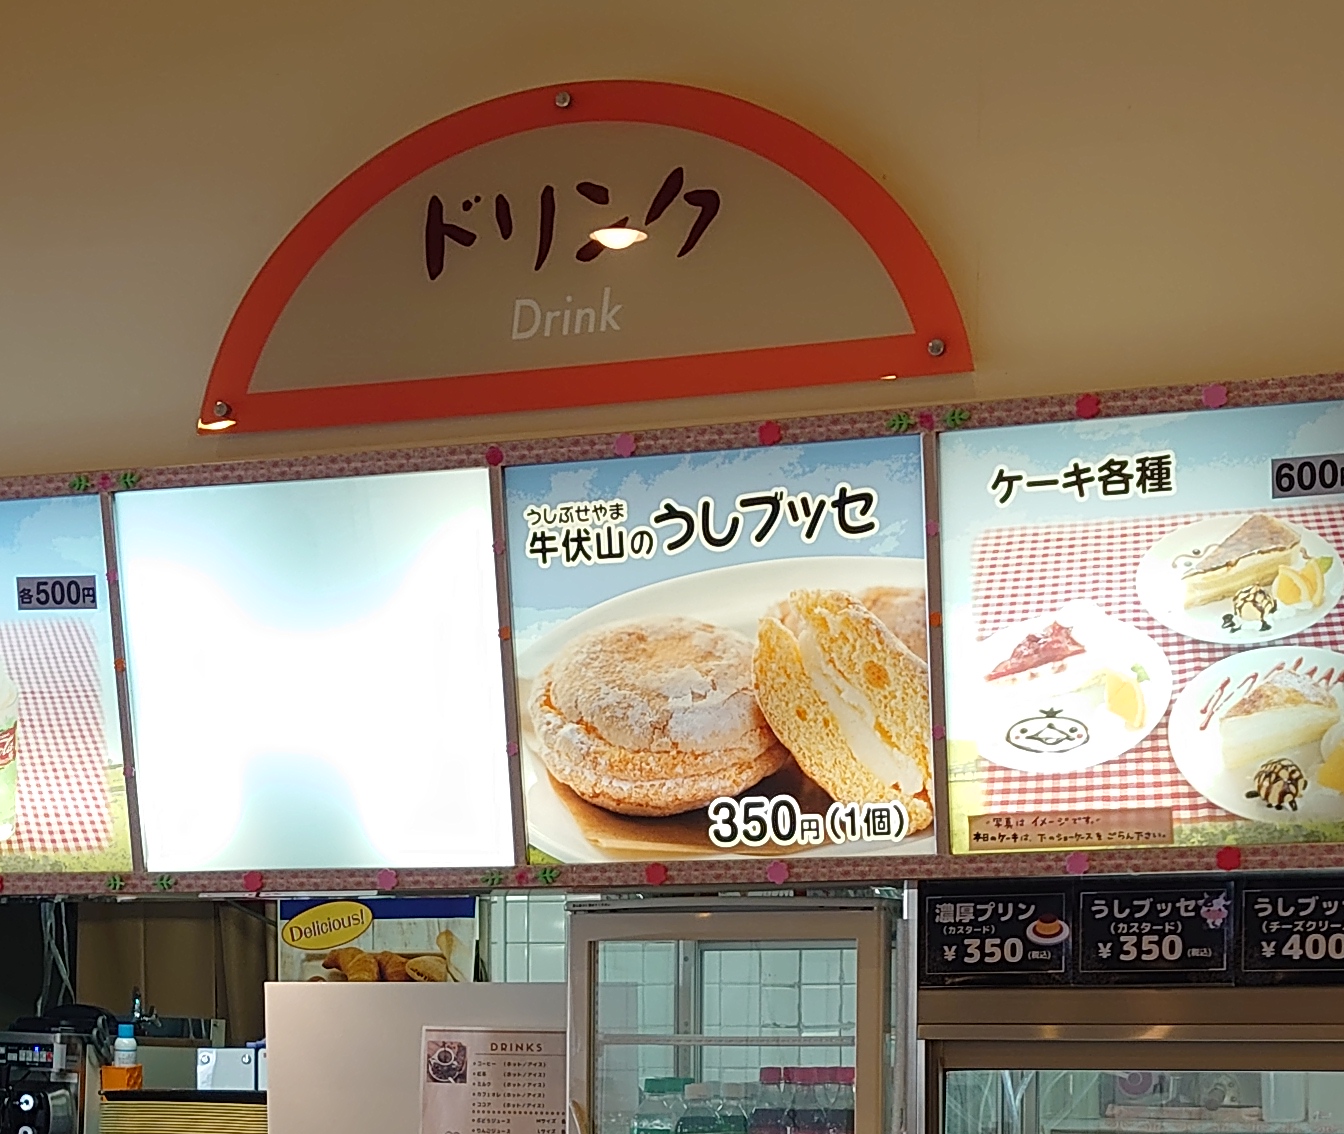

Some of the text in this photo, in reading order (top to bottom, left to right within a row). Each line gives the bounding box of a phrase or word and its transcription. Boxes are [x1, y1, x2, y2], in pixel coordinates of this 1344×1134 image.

[425, 166, 721, 281] ドリンク
[511, 287, 623, 341] Drink
[990, 453, 1173, 503] ケーキ各種
[527, 502, 625, 525] うしぶせやま
[18, 578, 96, 609] 各500円
[935, 902, 1036, 923] 濃厚プリン
[1091, 898, 1196, 919] うしブッセ
[288, 909, 366, 944] Delicious!
[1110, 921, 1182, 934] (カスタード)
[490, 1042, 543, 1053] DRINKS
